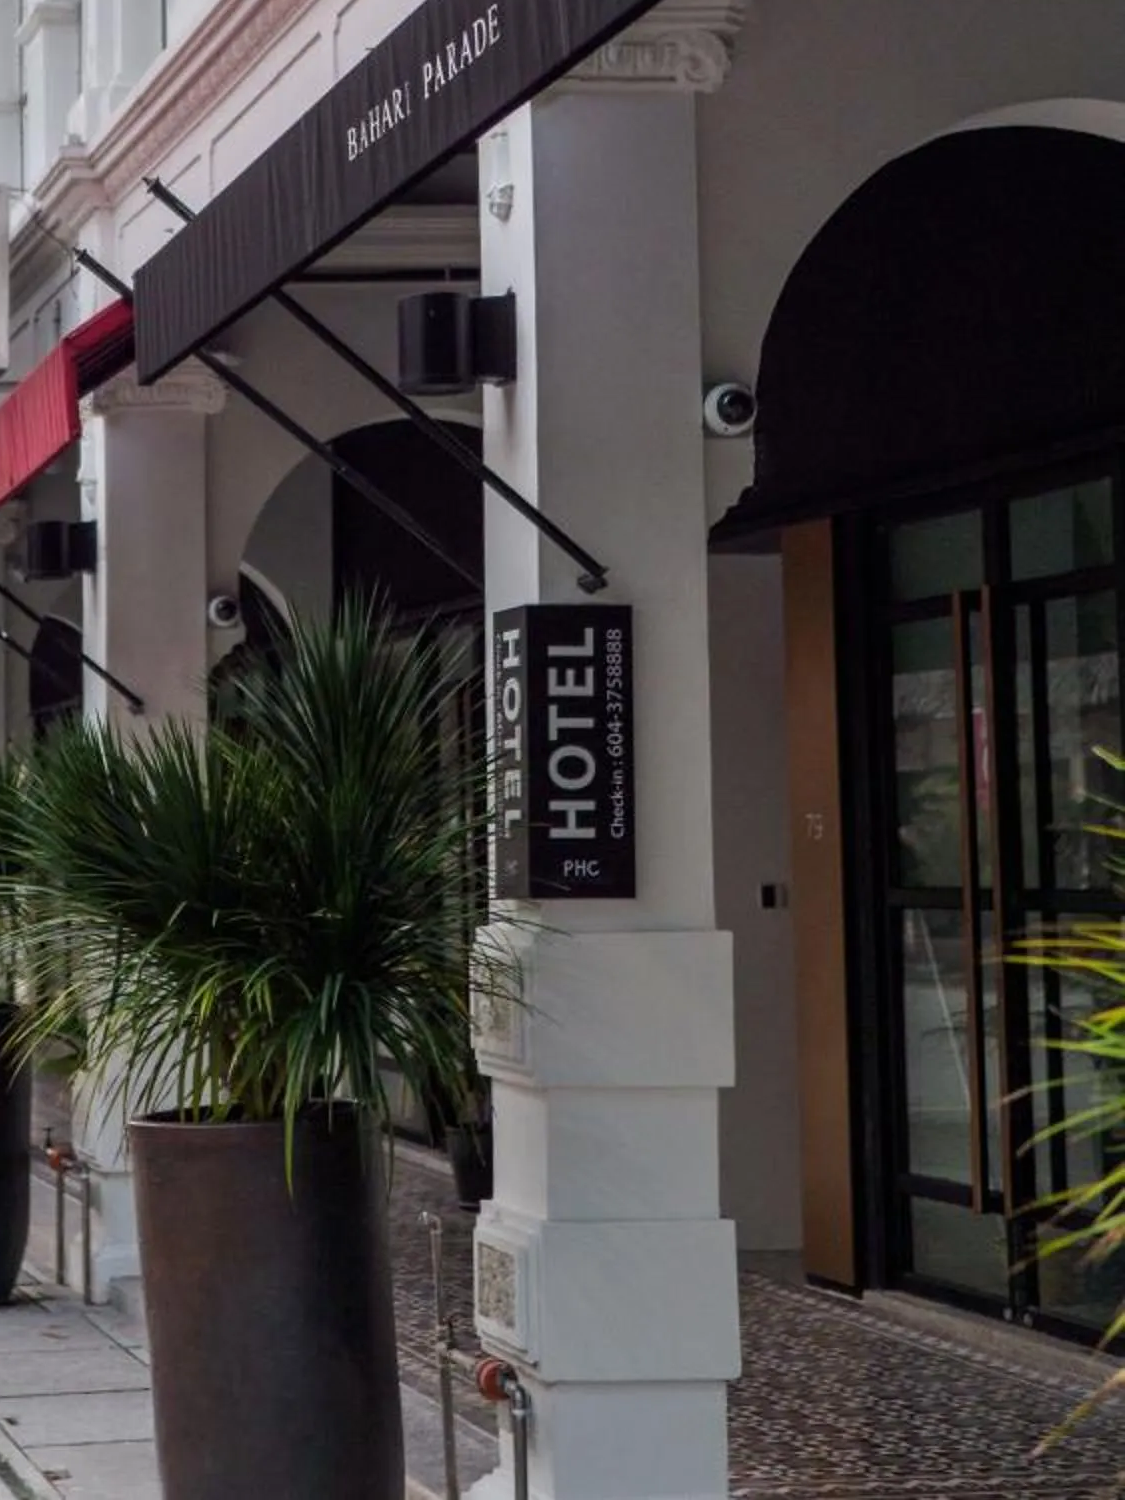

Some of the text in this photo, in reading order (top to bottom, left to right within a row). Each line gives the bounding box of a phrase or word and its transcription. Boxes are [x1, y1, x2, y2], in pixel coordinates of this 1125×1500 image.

[346, 3, 501, 162] BAHARI PARADE
[502, 627, 523, 839] HOTEL
[547, 627, 597, 839] HOTEL
[606, 628, 623, 758] 604-3758888
[563, 859, 601, 877] PHC
